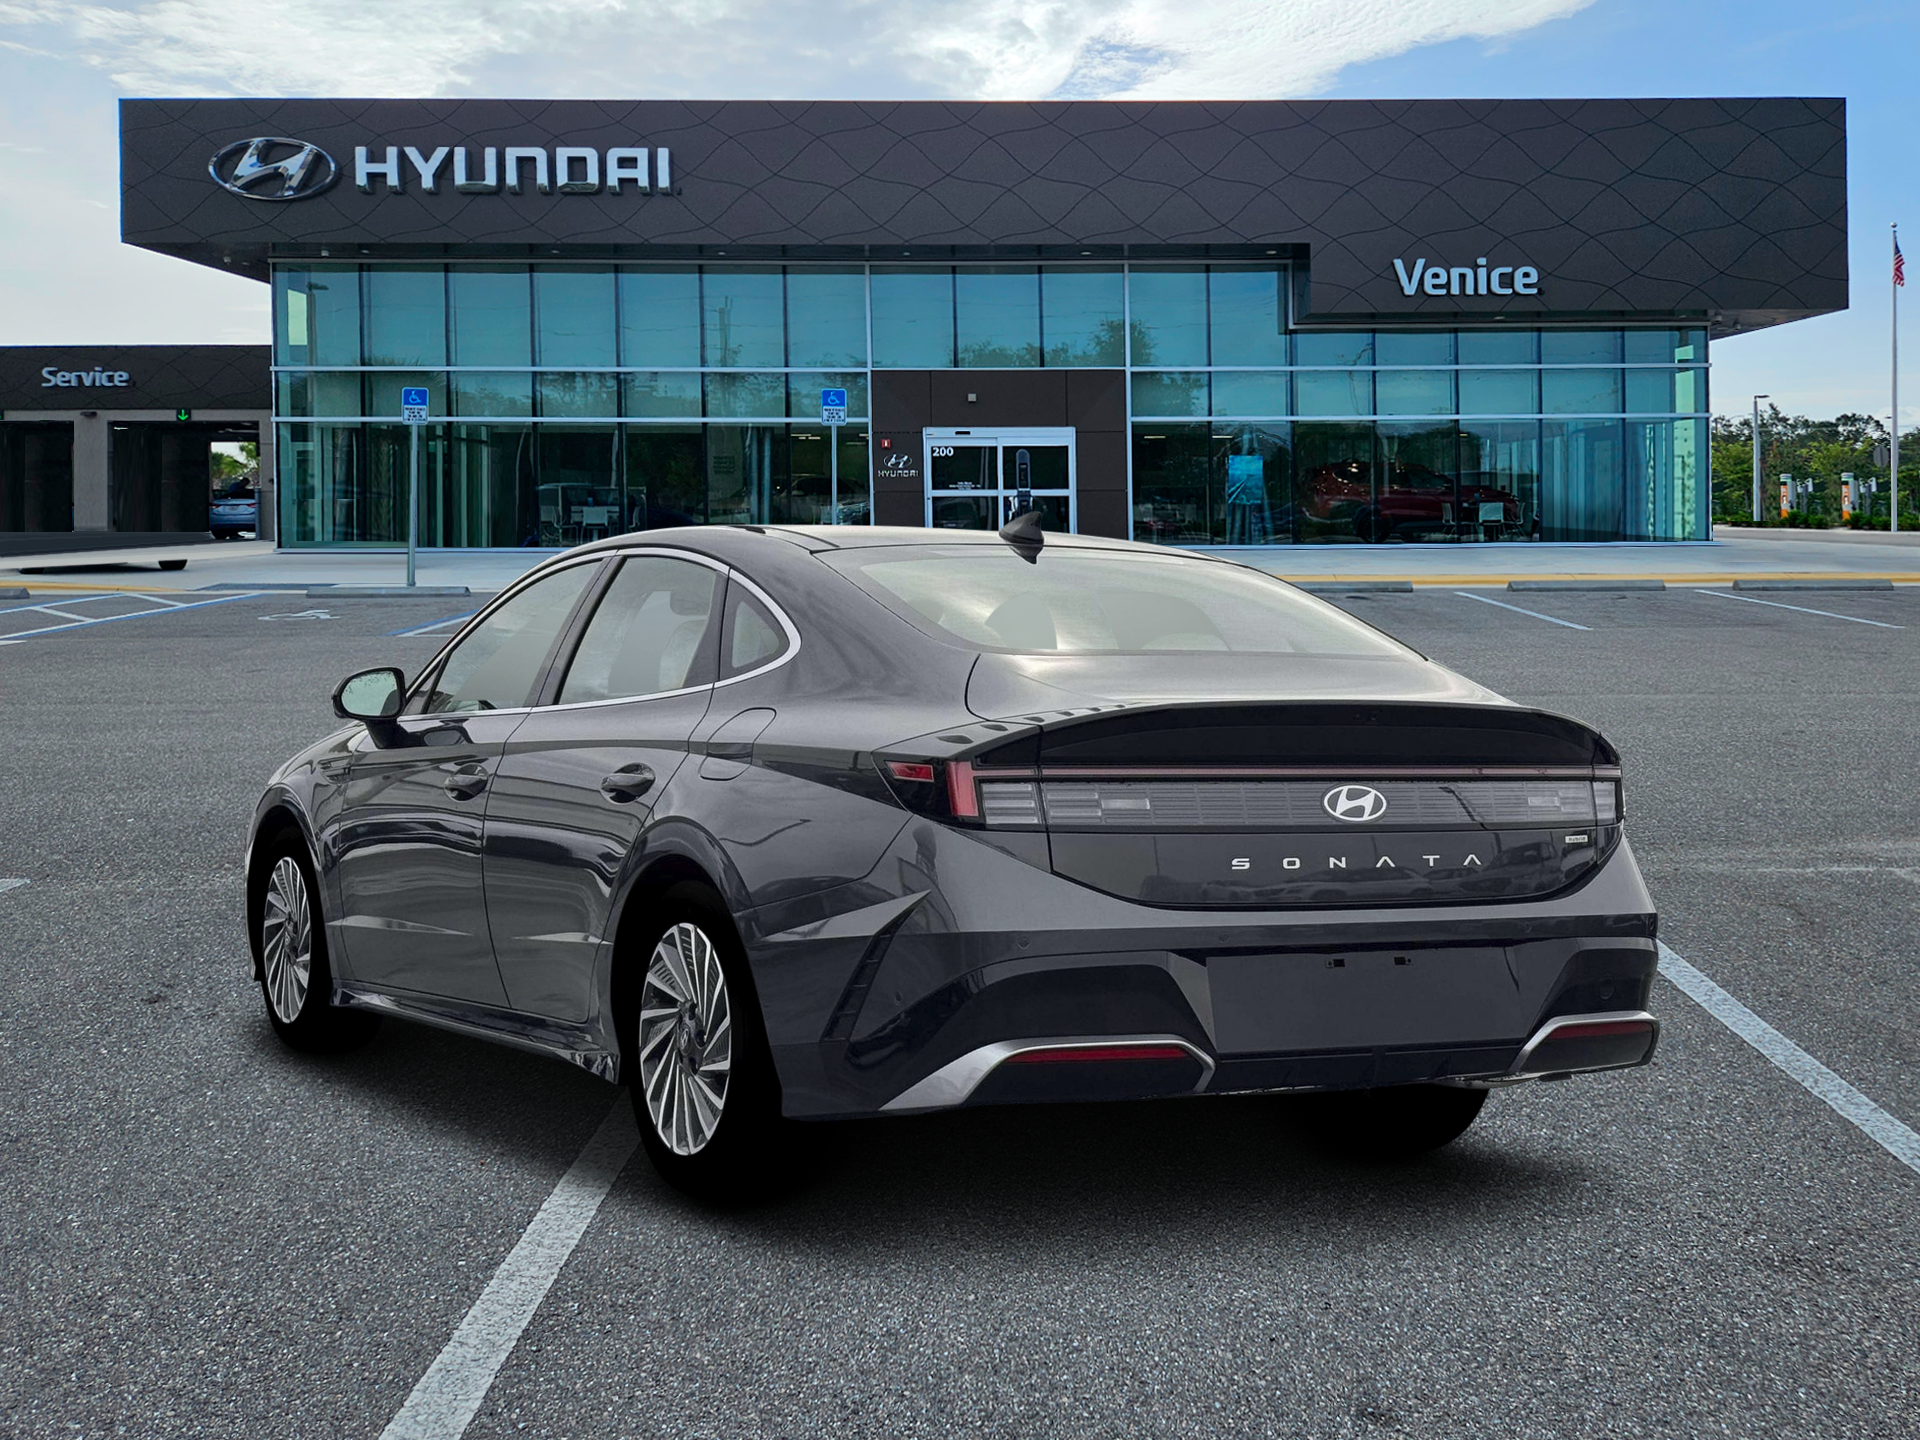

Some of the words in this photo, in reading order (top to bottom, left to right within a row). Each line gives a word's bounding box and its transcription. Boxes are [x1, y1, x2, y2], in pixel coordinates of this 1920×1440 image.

[355, 146, 670, 193] HYUNDAI
[1393, 257, 1539, 296] Venice
[41, 366, 130, 387] Service
[932, 446, 954, 457] 200
[877, 470, 919, 478] HYUNDAI
[1231, 854, 1482, 870] SONATA
